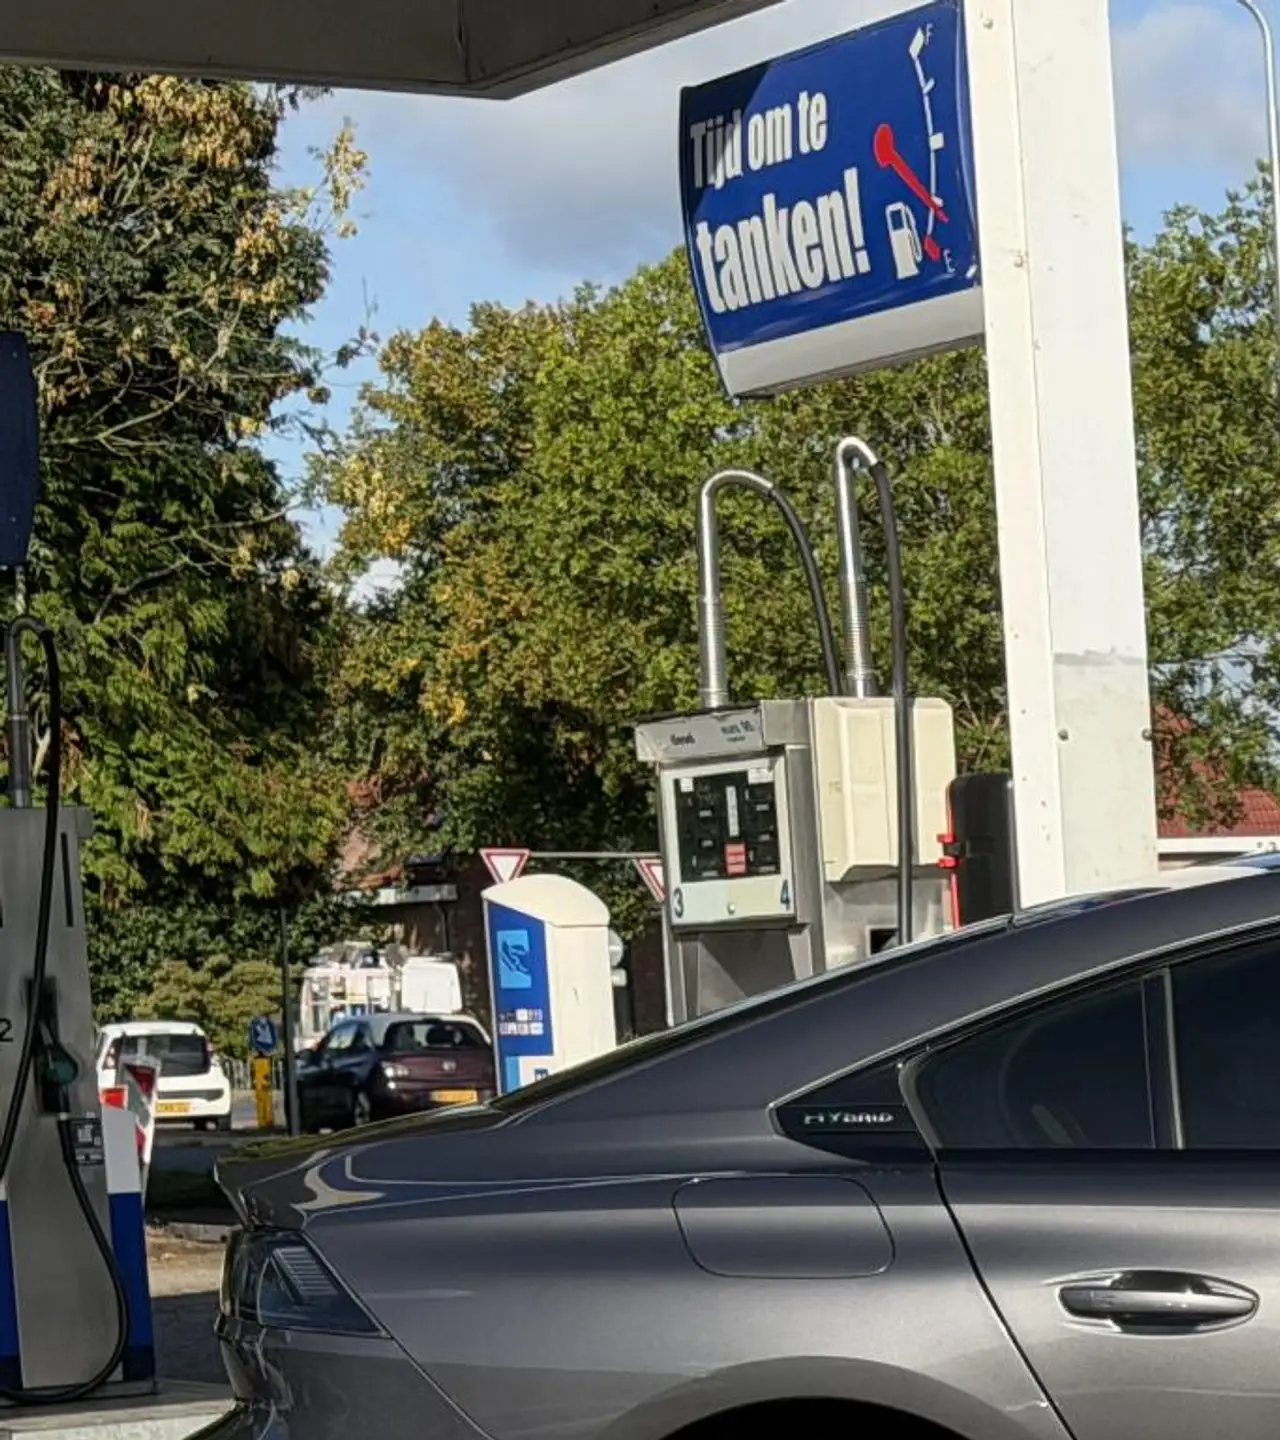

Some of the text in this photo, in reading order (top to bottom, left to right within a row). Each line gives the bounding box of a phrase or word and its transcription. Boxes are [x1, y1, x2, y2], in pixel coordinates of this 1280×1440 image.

[690, 90, 828, 190] Tijd om te
[696, 167, 871, 313] tanken!
[672, 879, 791, 918] 3 4
[803, 1111, 894, 1125] HYBRID
